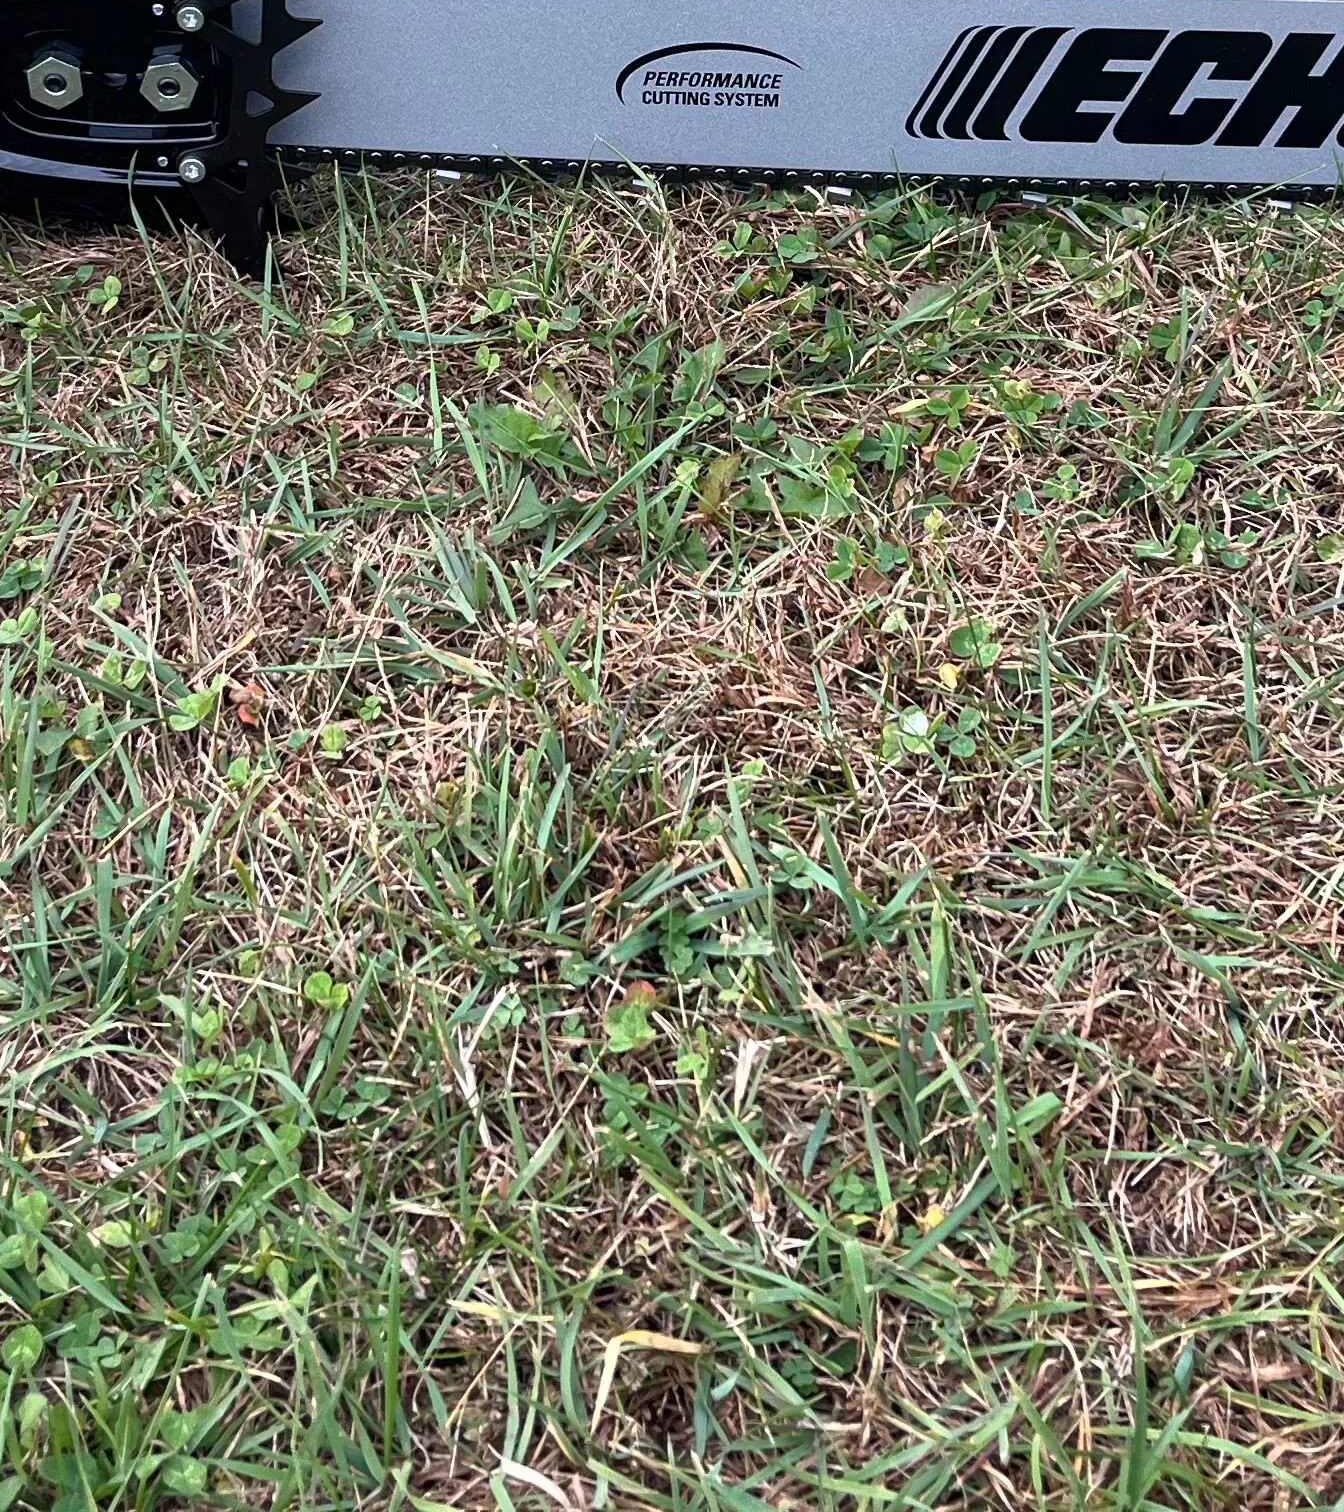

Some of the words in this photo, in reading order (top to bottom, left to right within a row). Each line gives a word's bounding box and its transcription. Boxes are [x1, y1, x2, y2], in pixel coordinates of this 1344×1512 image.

[643, 71, 783, 89] PERFORMANCE
[641, 90, 711, 106] CUTTING
[713, 91, 780, 108] SYSTEM
